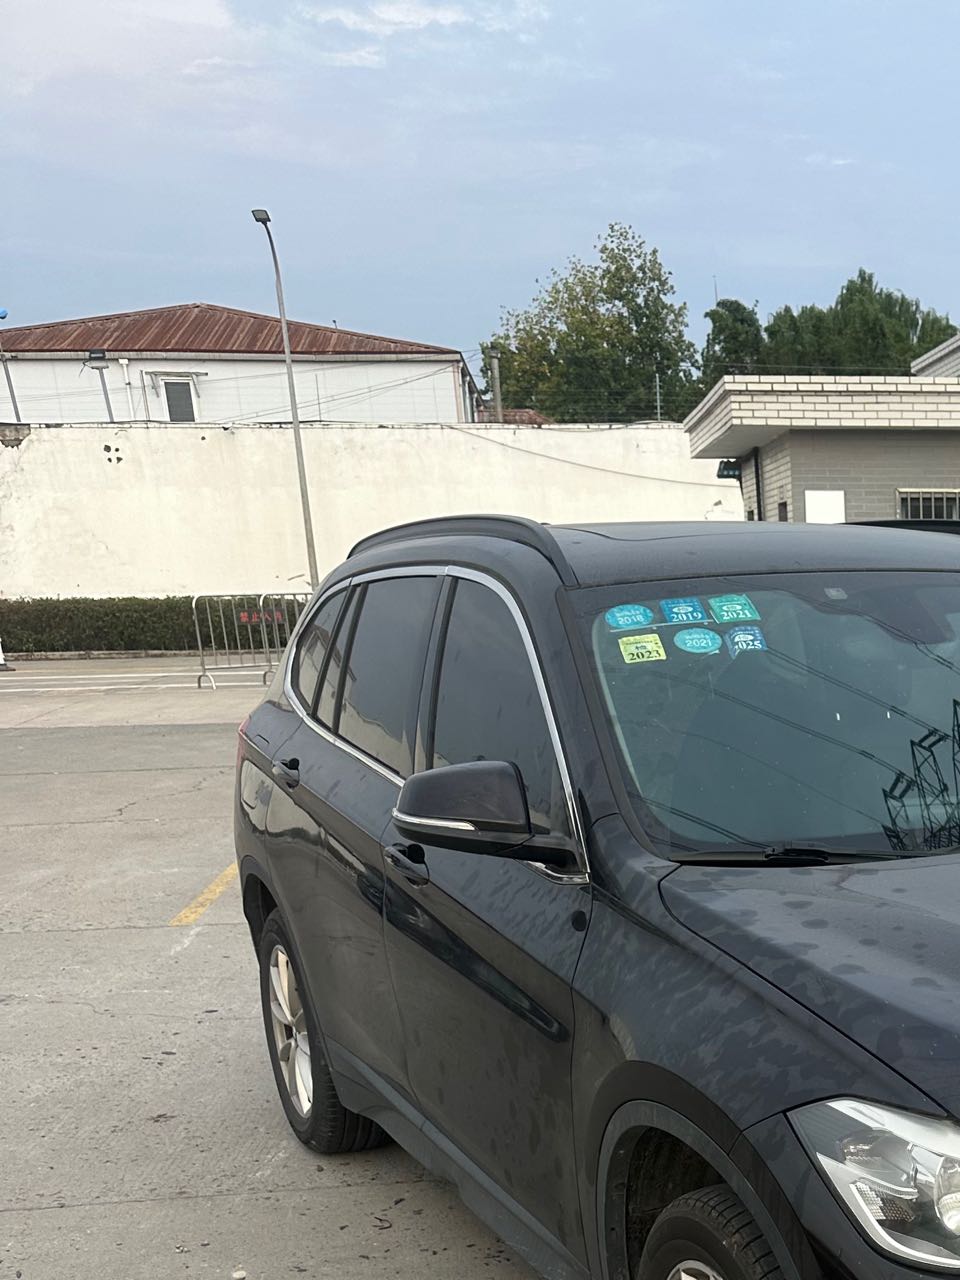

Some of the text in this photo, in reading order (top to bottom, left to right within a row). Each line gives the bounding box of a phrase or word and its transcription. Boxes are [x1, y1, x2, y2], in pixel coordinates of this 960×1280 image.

[670, 612, 702, 622] 2019
[720, 609, 752, 620] 2021
[685, 639, 712, 647] 2021
[734, 640, 762, 650] 025
[627, 649, 661, 661] 2023
